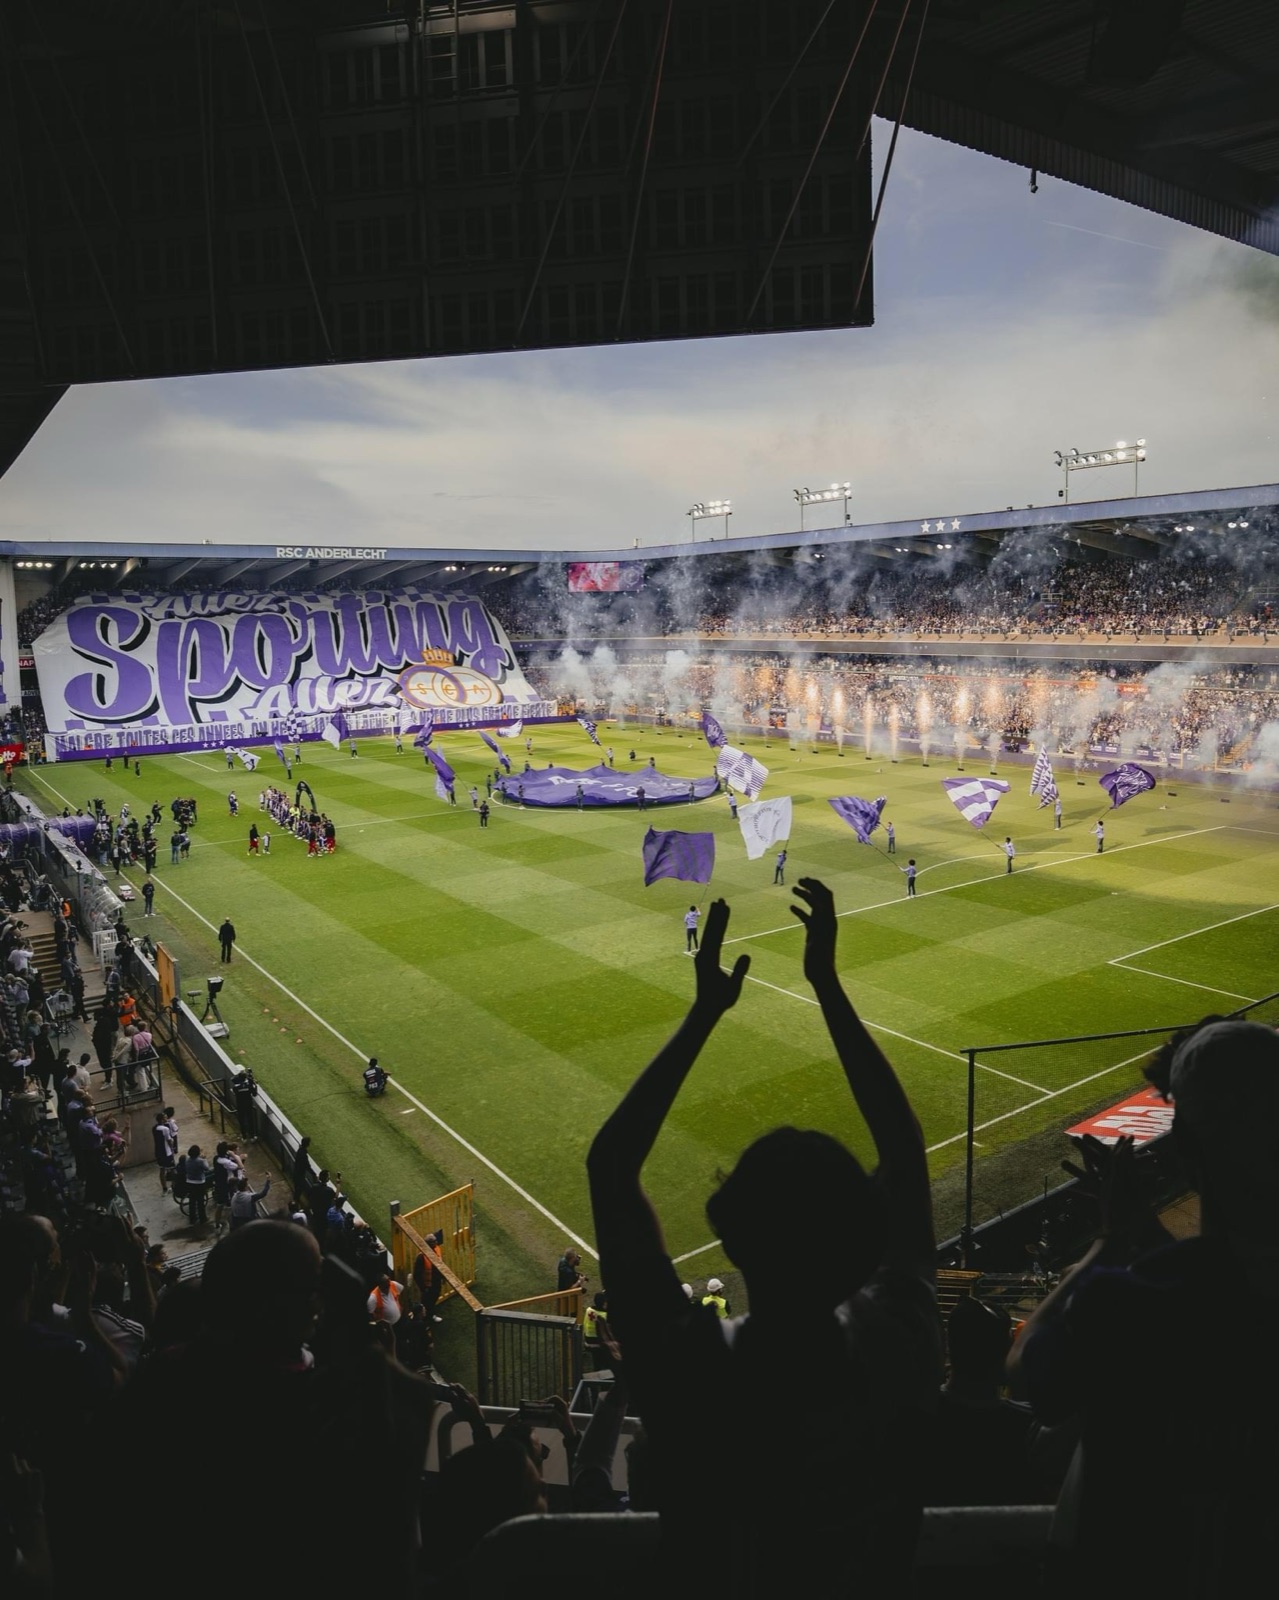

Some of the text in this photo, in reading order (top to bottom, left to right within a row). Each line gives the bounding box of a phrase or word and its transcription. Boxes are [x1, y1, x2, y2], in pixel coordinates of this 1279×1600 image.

[276, 547, 387, 560] RSC ANDERLECHT
[64, 591, 509, 726] Sporting
[116, 729, 168, 748] TOUTES
